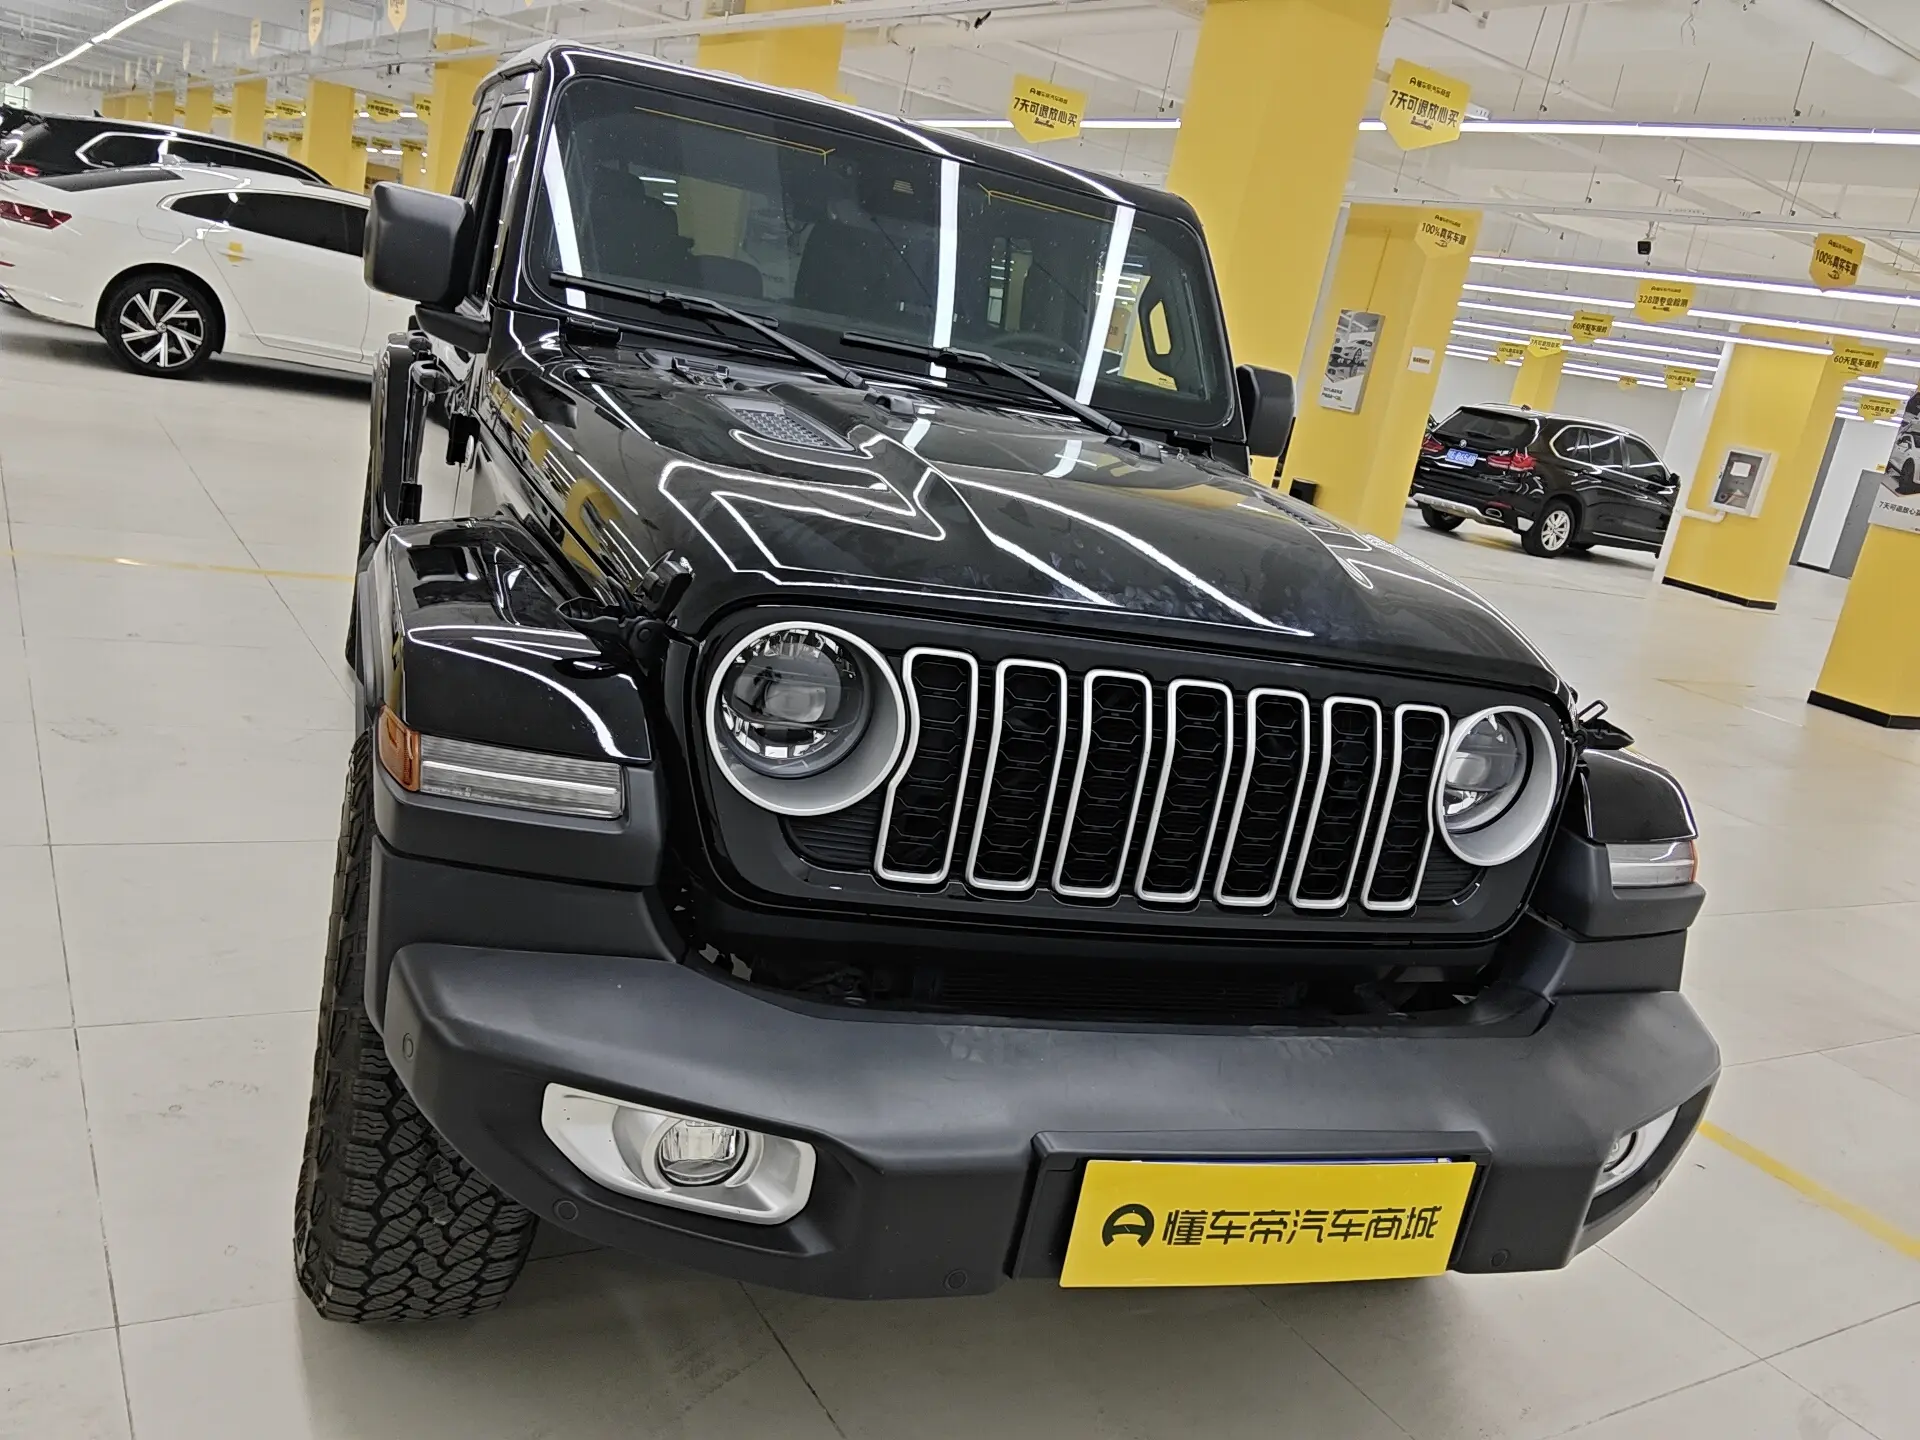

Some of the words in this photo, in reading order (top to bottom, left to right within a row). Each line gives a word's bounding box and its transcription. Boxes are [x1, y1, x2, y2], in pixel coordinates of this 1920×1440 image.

[1014, 97, 1078, 127] 7天可退放心买
[1389, 90, 1459, 127] 7天可退放心买
[1421, 222, 1467, 246] 100%真实车源
[1815, 249, 1858, 277] 100%真实车源
[1638, 294, 1689, 307] 328项专业检测
[1162, 1205, 1443, 1245] 懂车帝汽车商城
